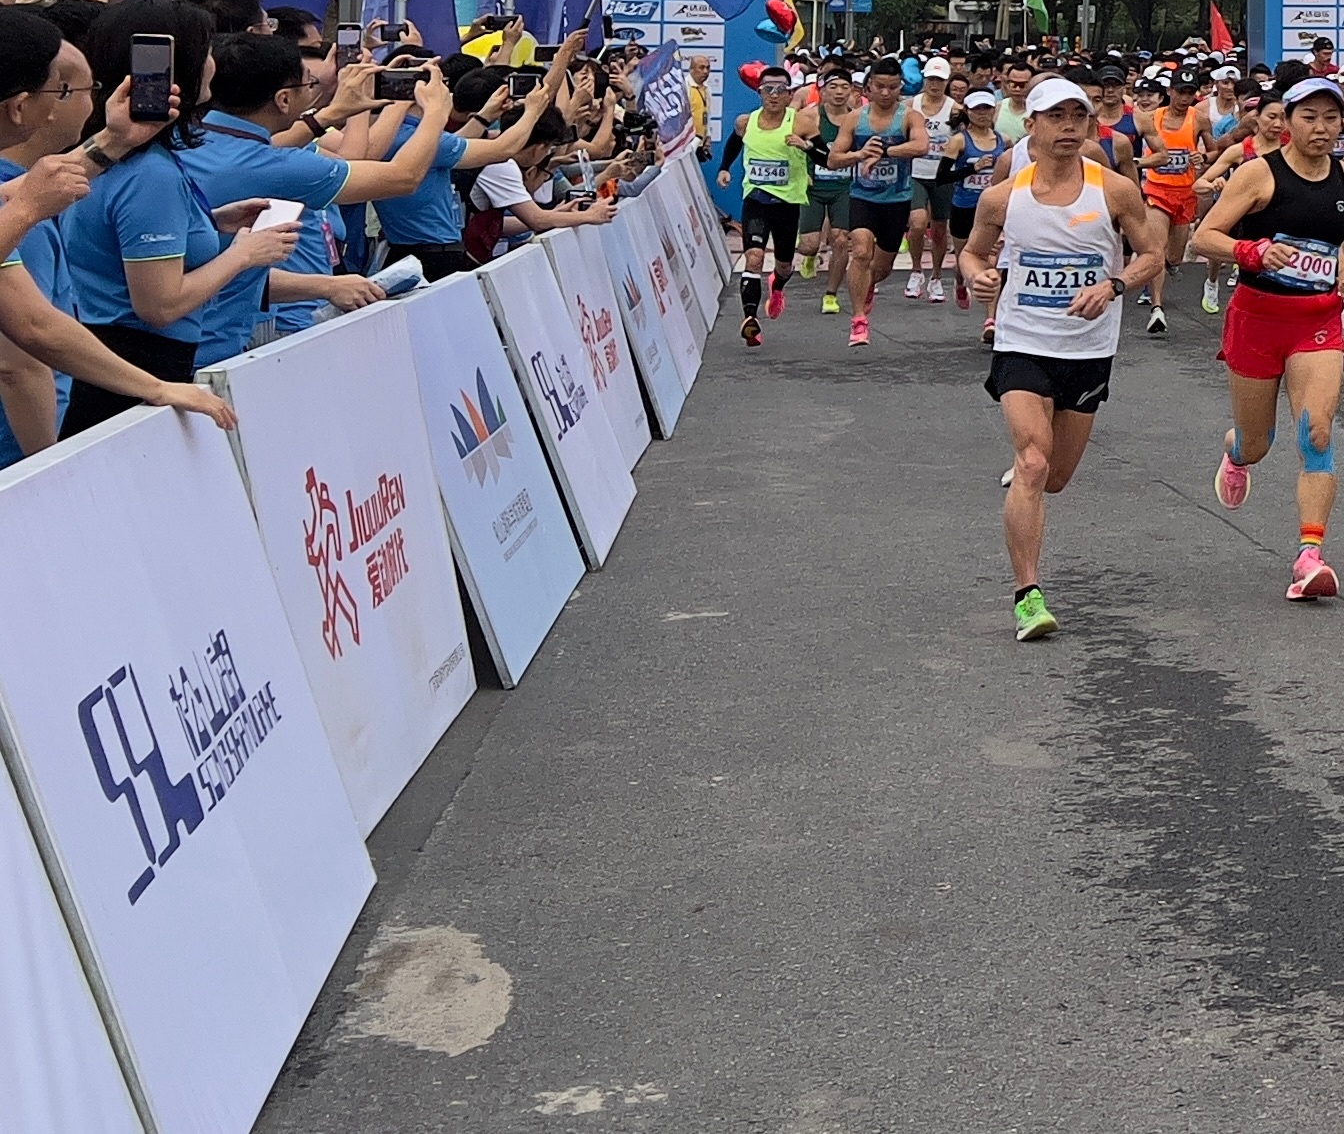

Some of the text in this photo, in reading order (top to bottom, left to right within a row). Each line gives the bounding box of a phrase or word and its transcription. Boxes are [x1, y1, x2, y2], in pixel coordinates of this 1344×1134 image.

[1025, 269, 1097, 288] A1218
[365, 528, 409, 610] 爱动时代
